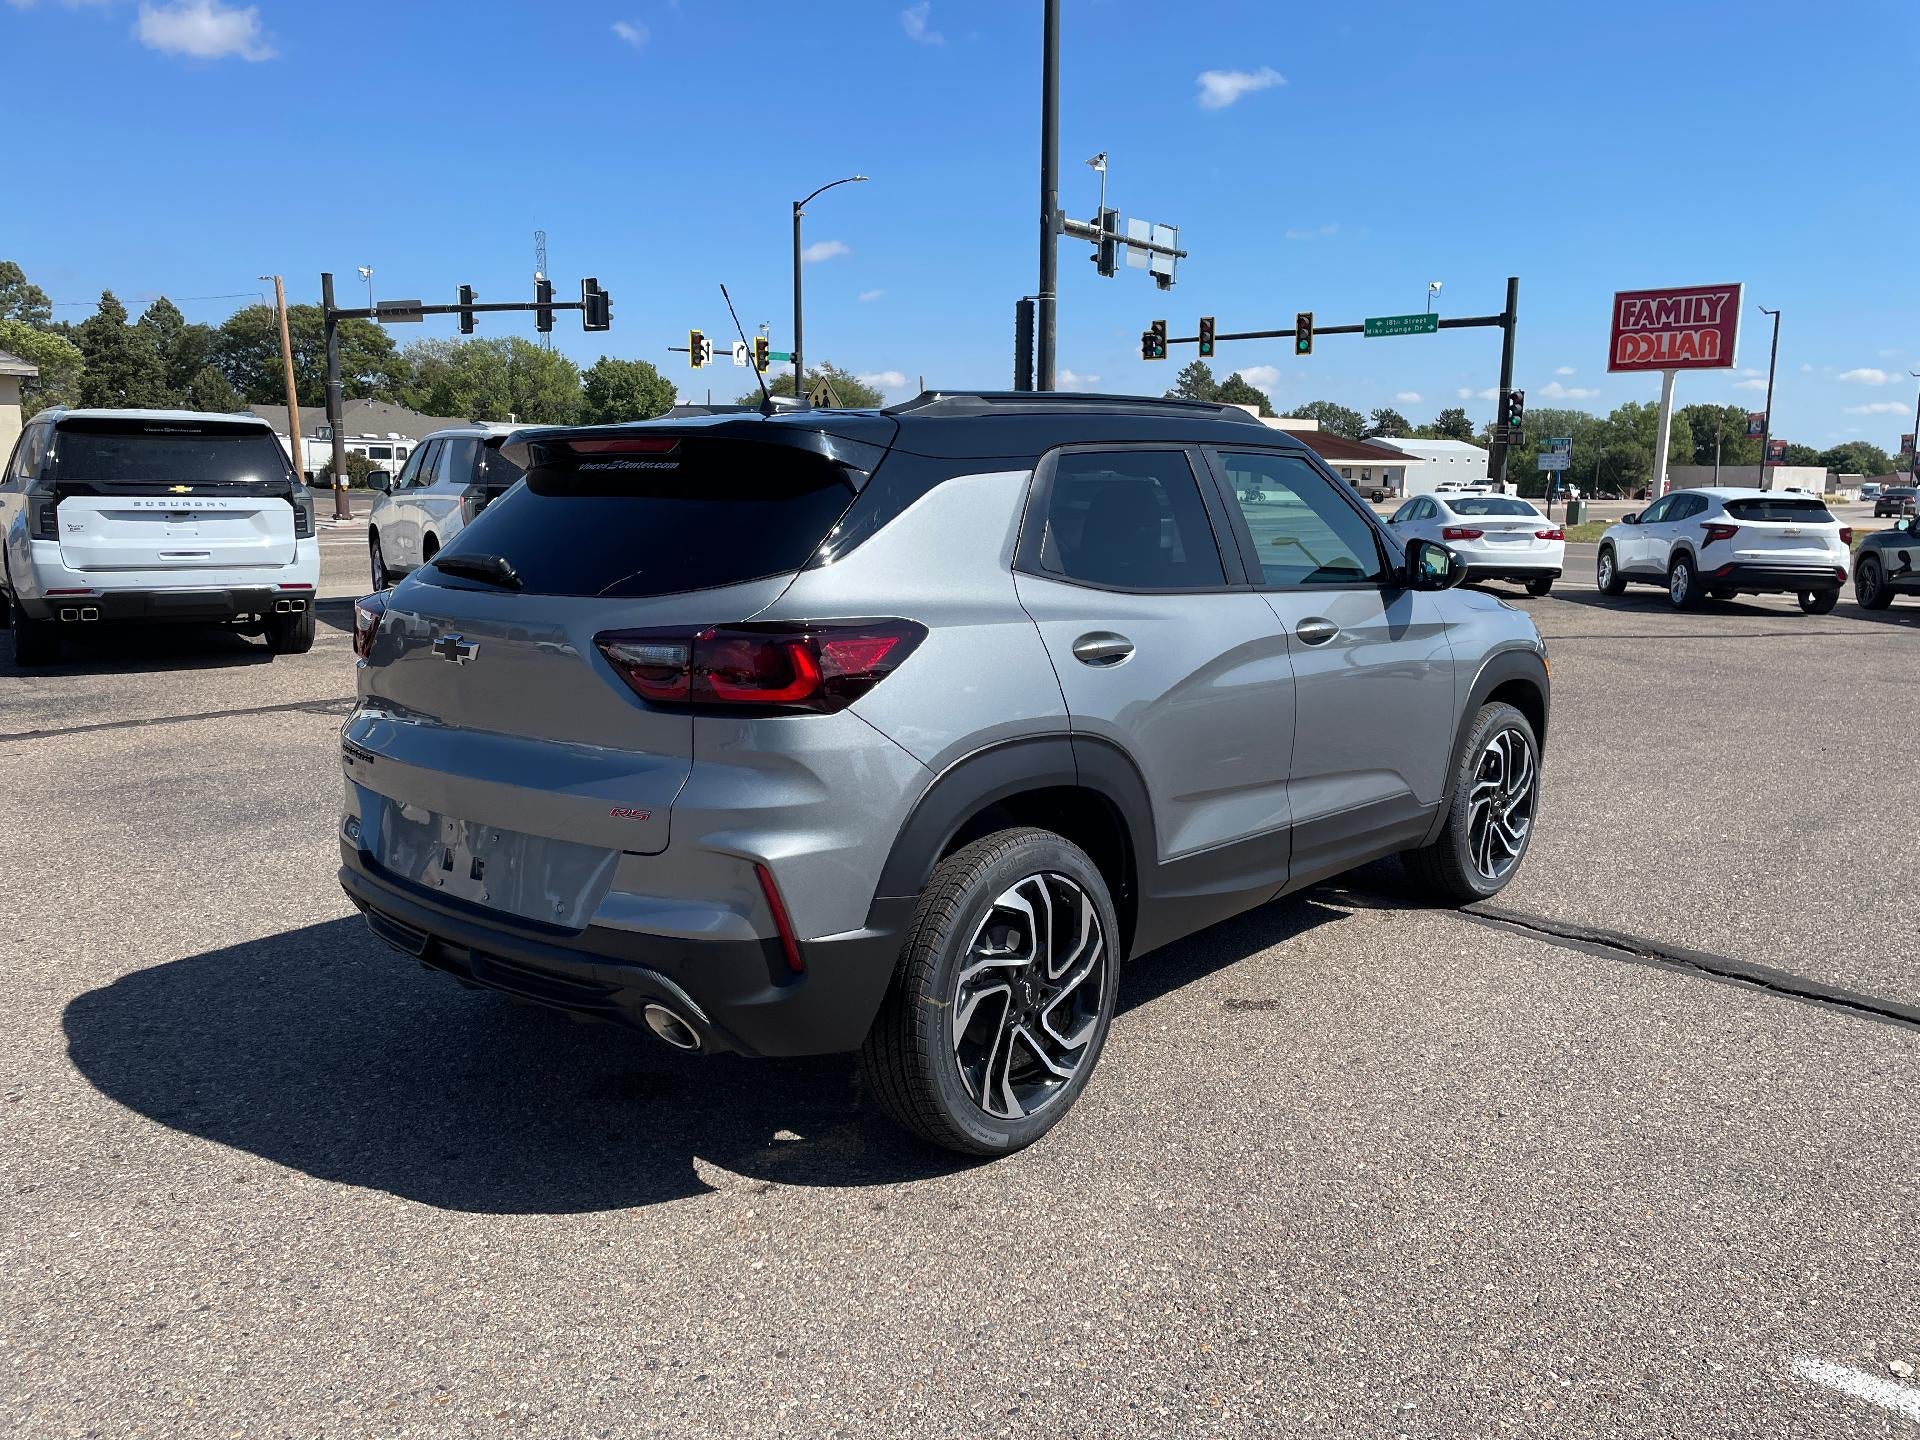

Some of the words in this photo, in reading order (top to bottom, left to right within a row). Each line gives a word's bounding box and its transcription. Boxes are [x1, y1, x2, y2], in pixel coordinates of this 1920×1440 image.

[1620, 293, 1730, 330] FAMILY
[1616, 328, 1720, 363] DOLLAR
[609, 806, 651, 821] RS
